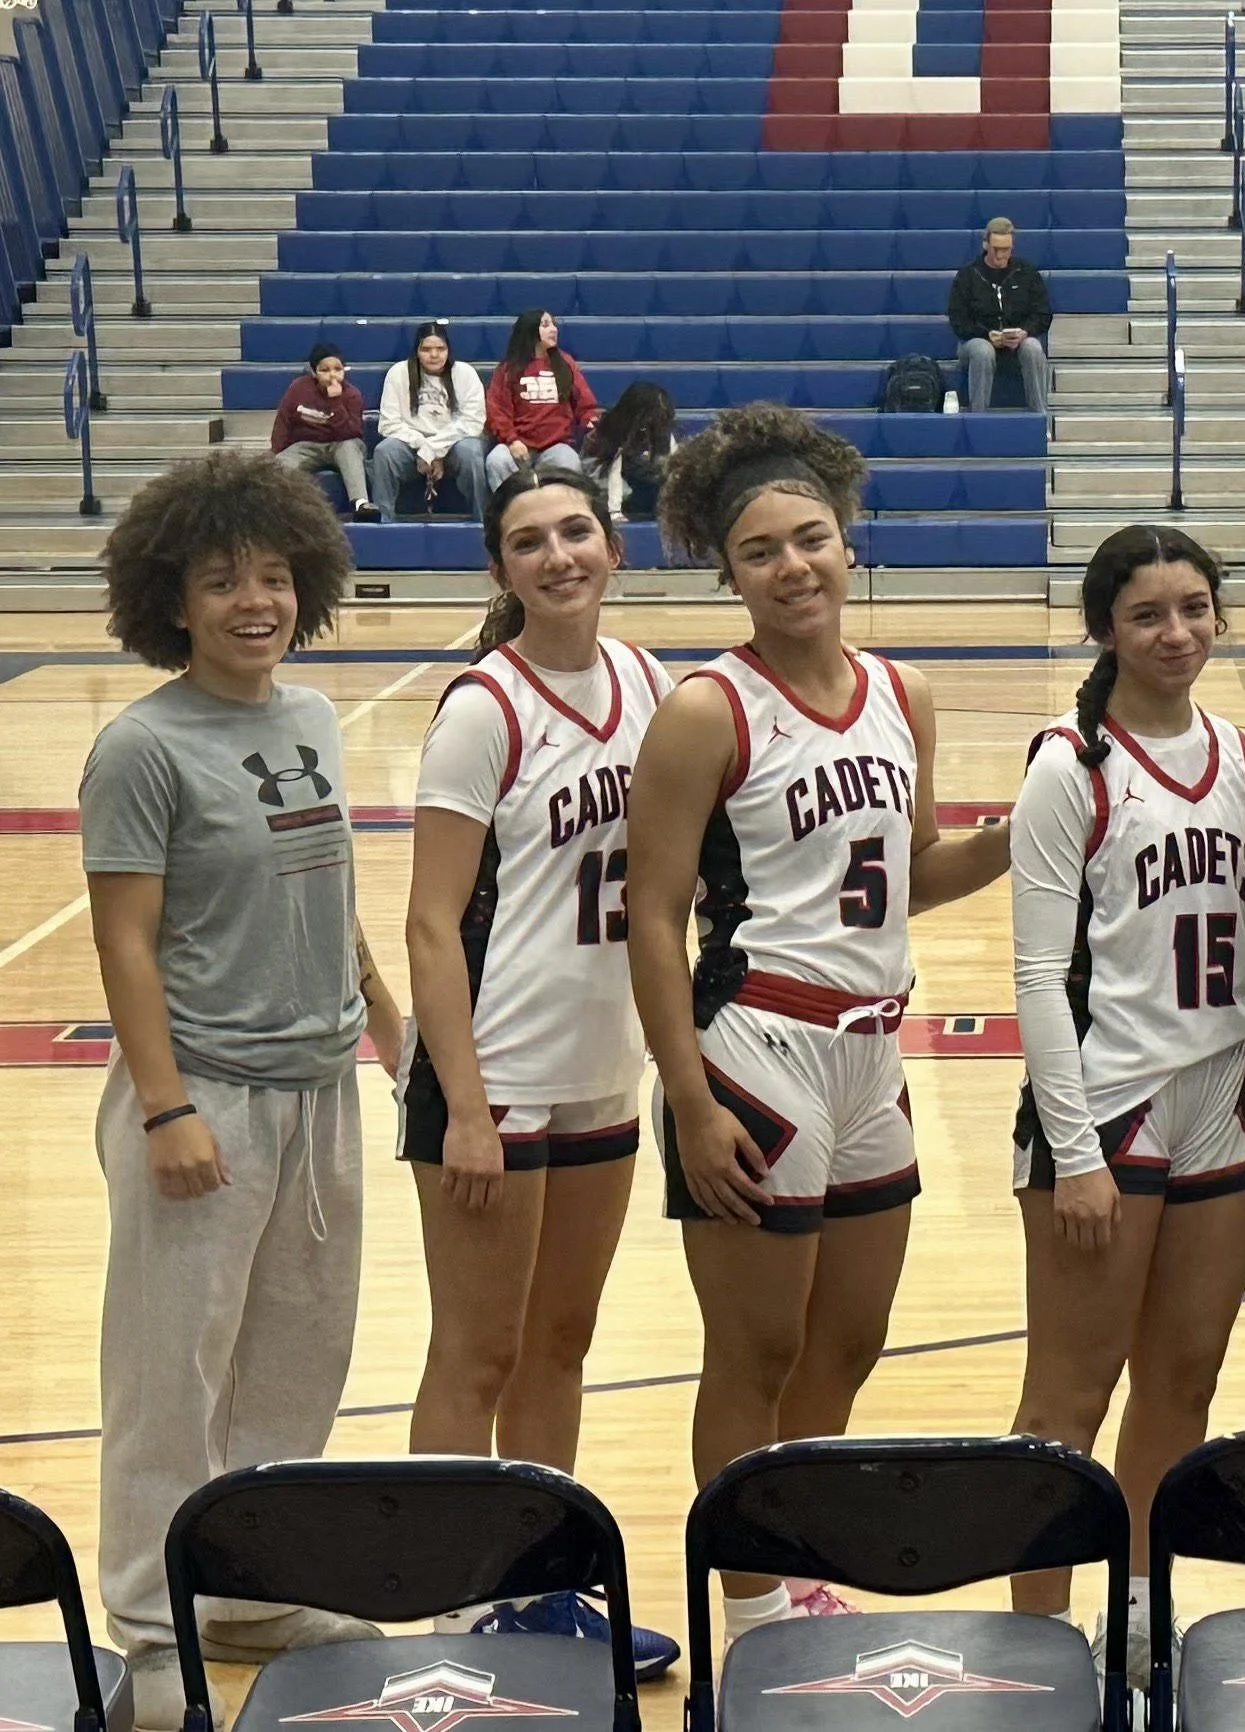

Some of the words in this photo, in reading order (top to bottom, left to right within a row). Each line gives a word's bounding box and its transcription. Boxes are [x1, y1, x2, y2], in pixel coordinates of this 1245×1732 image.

[548, 764, 632, 849] CADE
[785, 755, 913, 842] CADETS
[839, 836, 888, 929] 5
[1172, 912, 1238, 1010] 15
[411, 1696, 455, 1713] IKE
[890, 1672, 929, 1688] IKE
